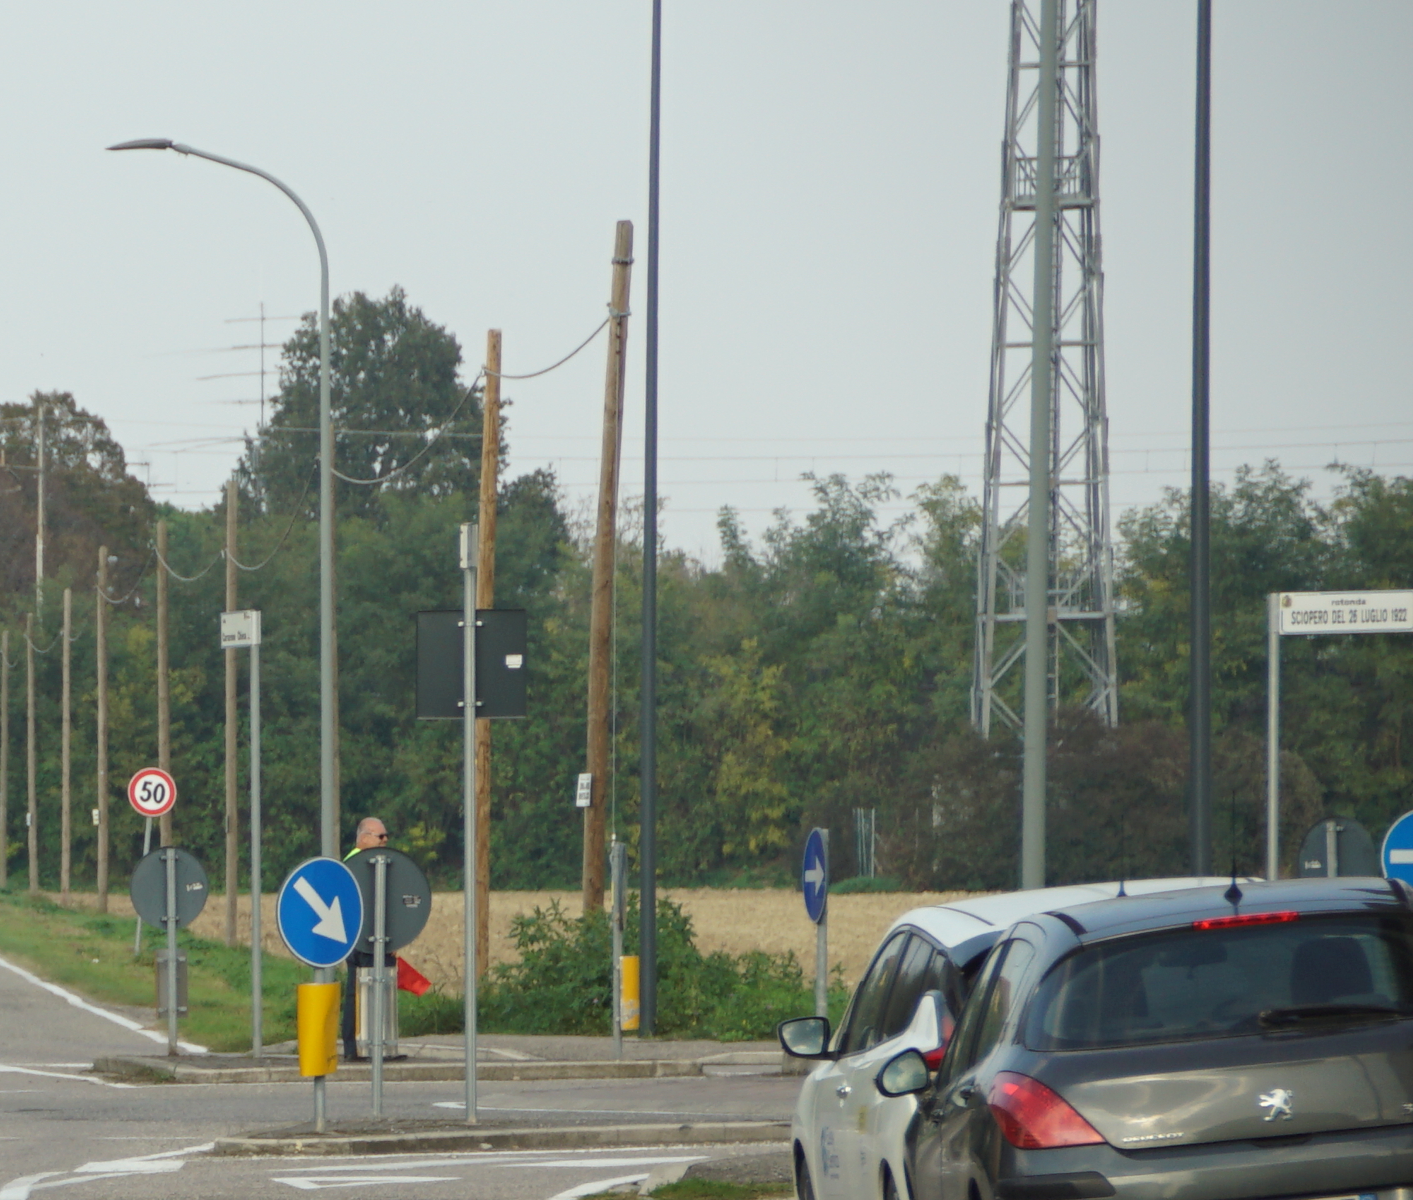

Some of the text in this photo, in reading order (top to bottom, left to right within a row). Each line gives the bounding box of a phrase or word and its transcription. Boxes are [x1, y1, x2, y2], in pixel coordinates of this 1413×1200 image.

[1291, 610, 1328, 625] SCIOPERO
[1332, 609, 1346, 624] DEL
[1361, 608, 1388, 623] LUGLIO
[1391, 608, 1408, 622] 1922
[139, 781, 166, 804] 50
